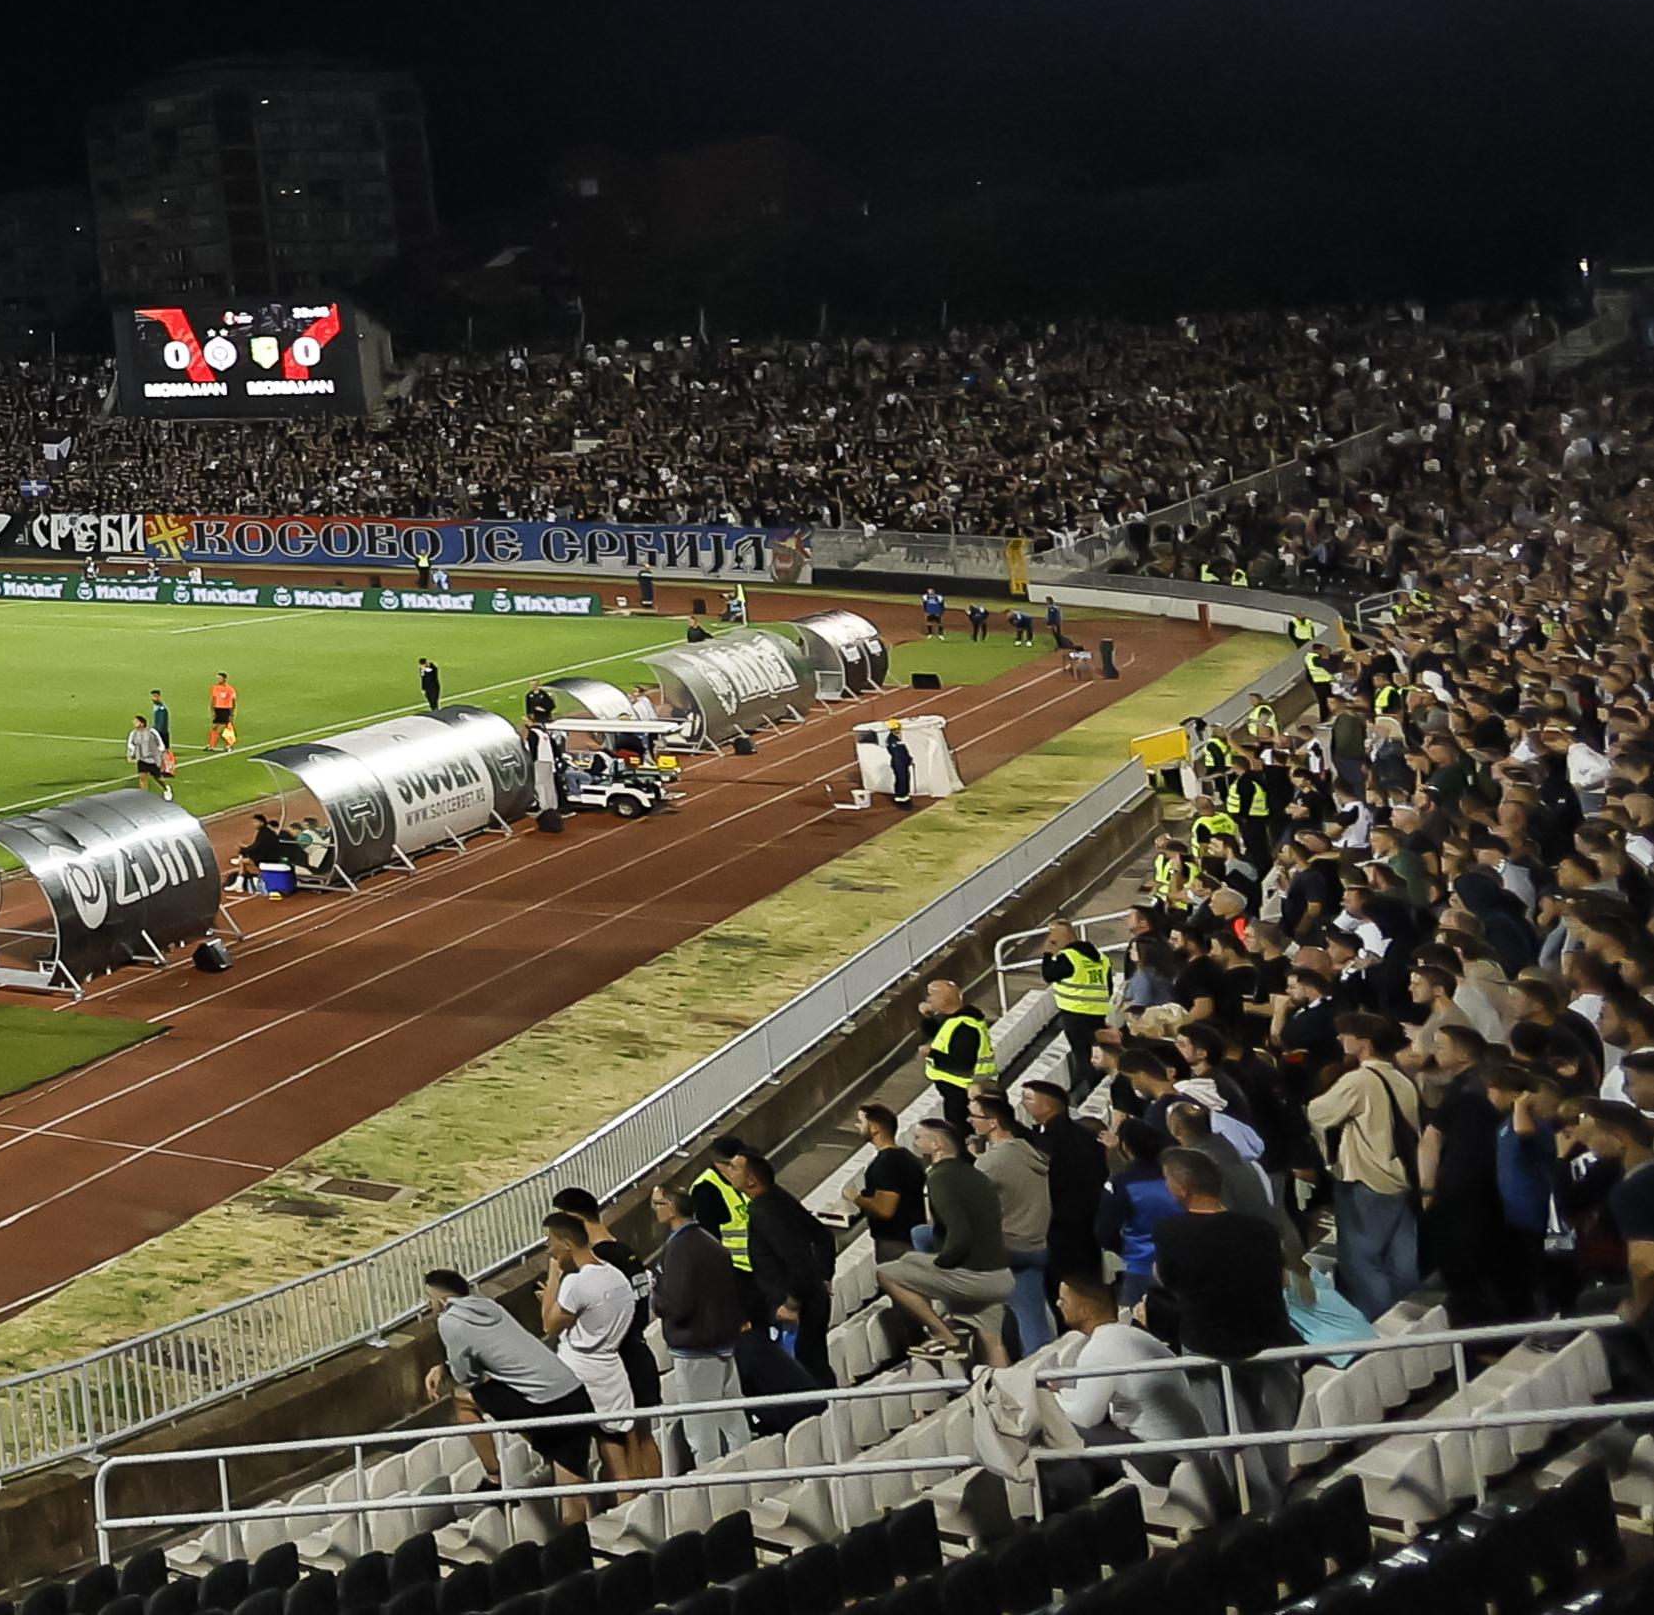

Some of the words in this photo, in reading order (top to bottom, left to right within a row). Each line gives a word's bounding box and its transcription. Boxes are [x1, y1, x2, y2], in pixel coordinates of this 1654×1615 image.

[163, 341, 191, 369] 0
[293, 336, 321, 366] 0
[190, 520, 444, 562] КОСОВО
[3, 582, 63, 598] MAXBET
[96, 585, 158, 601] MAXBET
[193, 588, 259, 604] MAXBET
[294, 589, 364, 608] MAXBET
[401, 593, 474, 611] MAXBET
[514, 594, 592, 614] MAXBET
